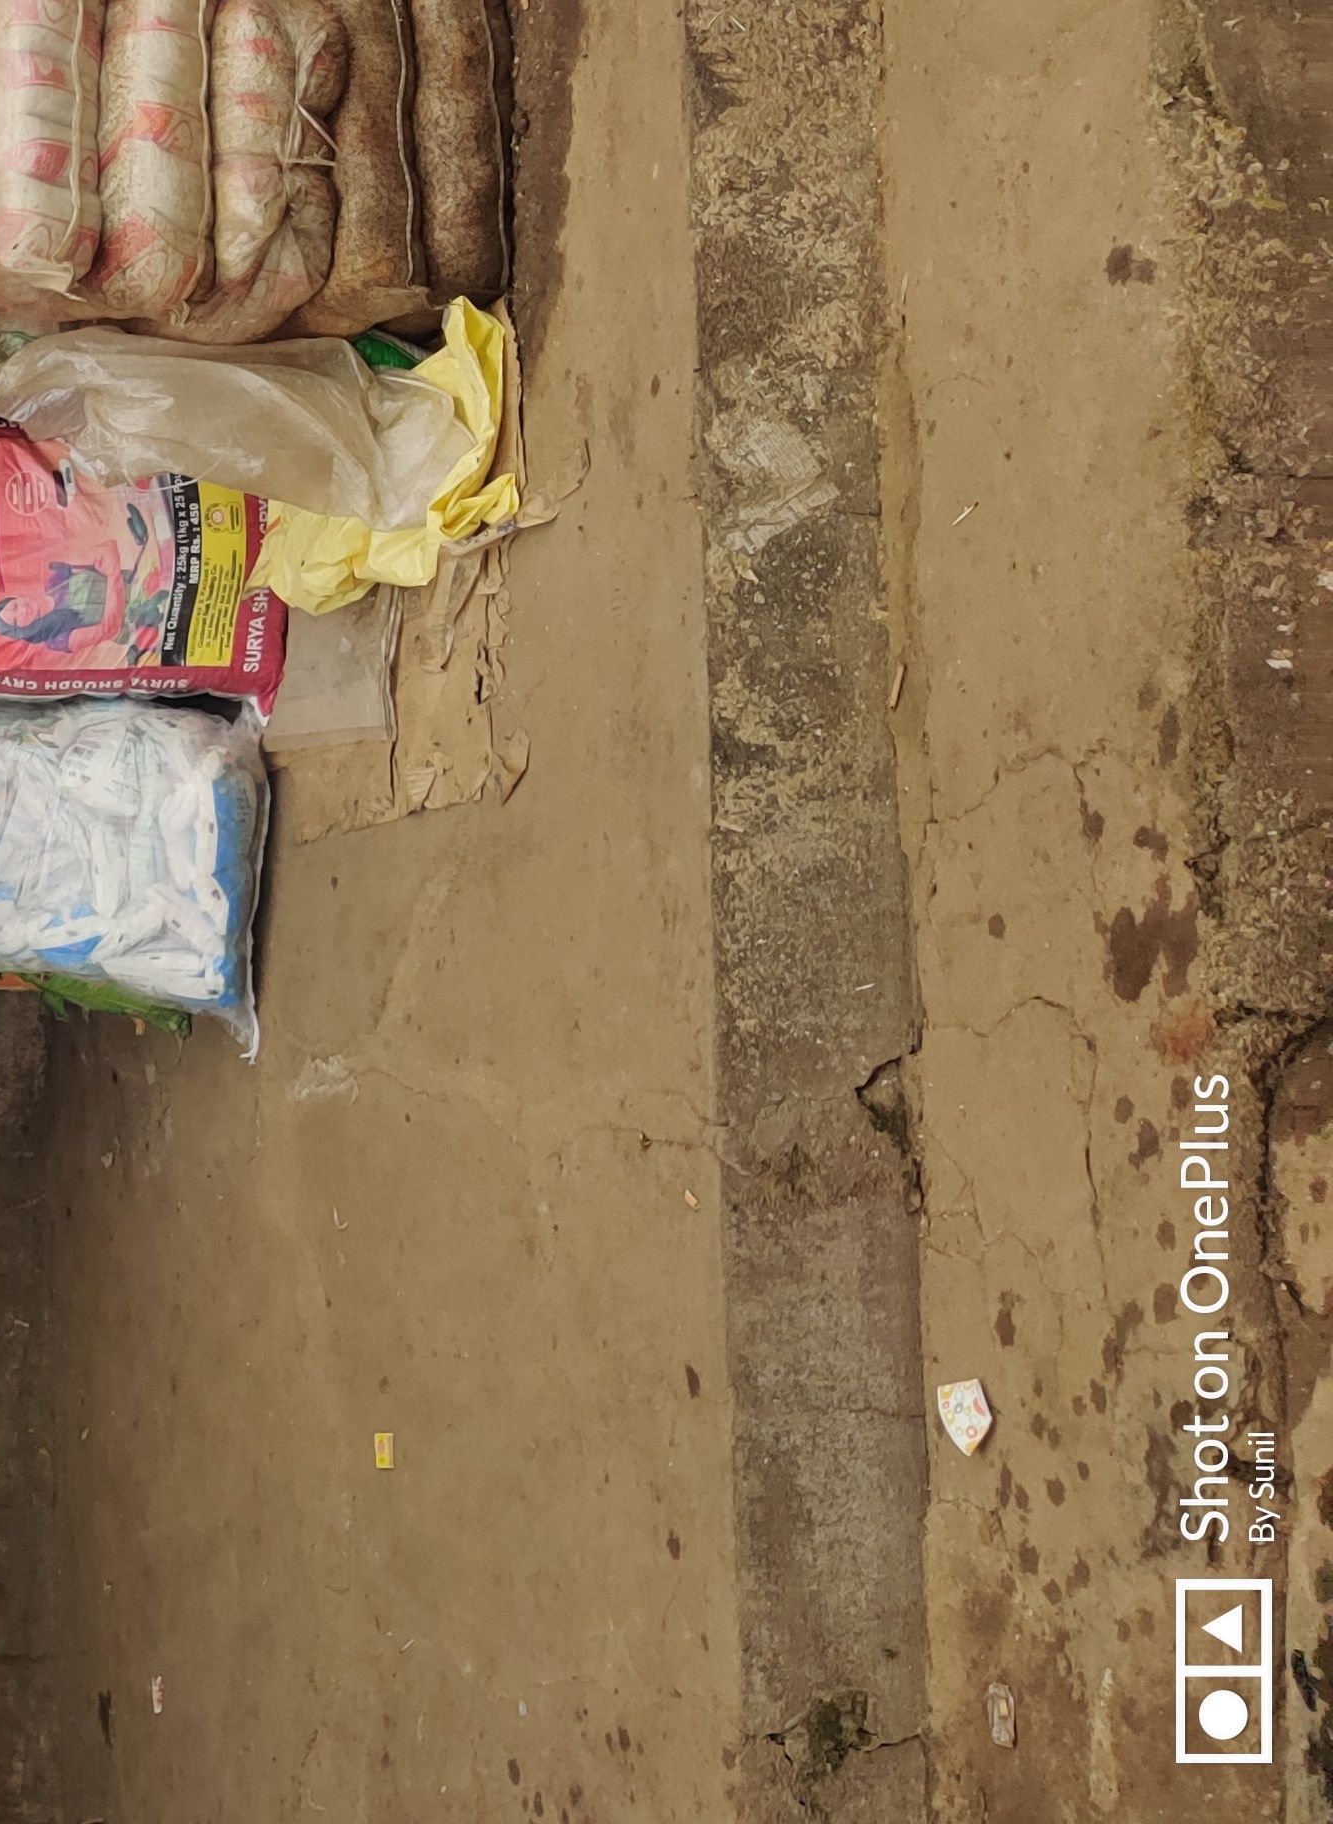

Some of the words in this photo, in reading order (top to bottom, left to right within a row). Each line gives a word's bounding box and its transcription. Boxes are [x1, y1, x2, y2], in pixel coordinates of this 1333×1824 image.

[174, 495, 186, 509] 25
[188, 502, 200, 525] 450
[190, 534, 201, 554] Rs.
[175, 546, 190, 573] 25kg
[188, 556, 200, 585] MRP
[166, 583, 187, 630] Quantity
[163, 631, 177, 651] Net
[242, 615, 266, 673] SURYA
[44, 678, 124, 691] SHUDDH
